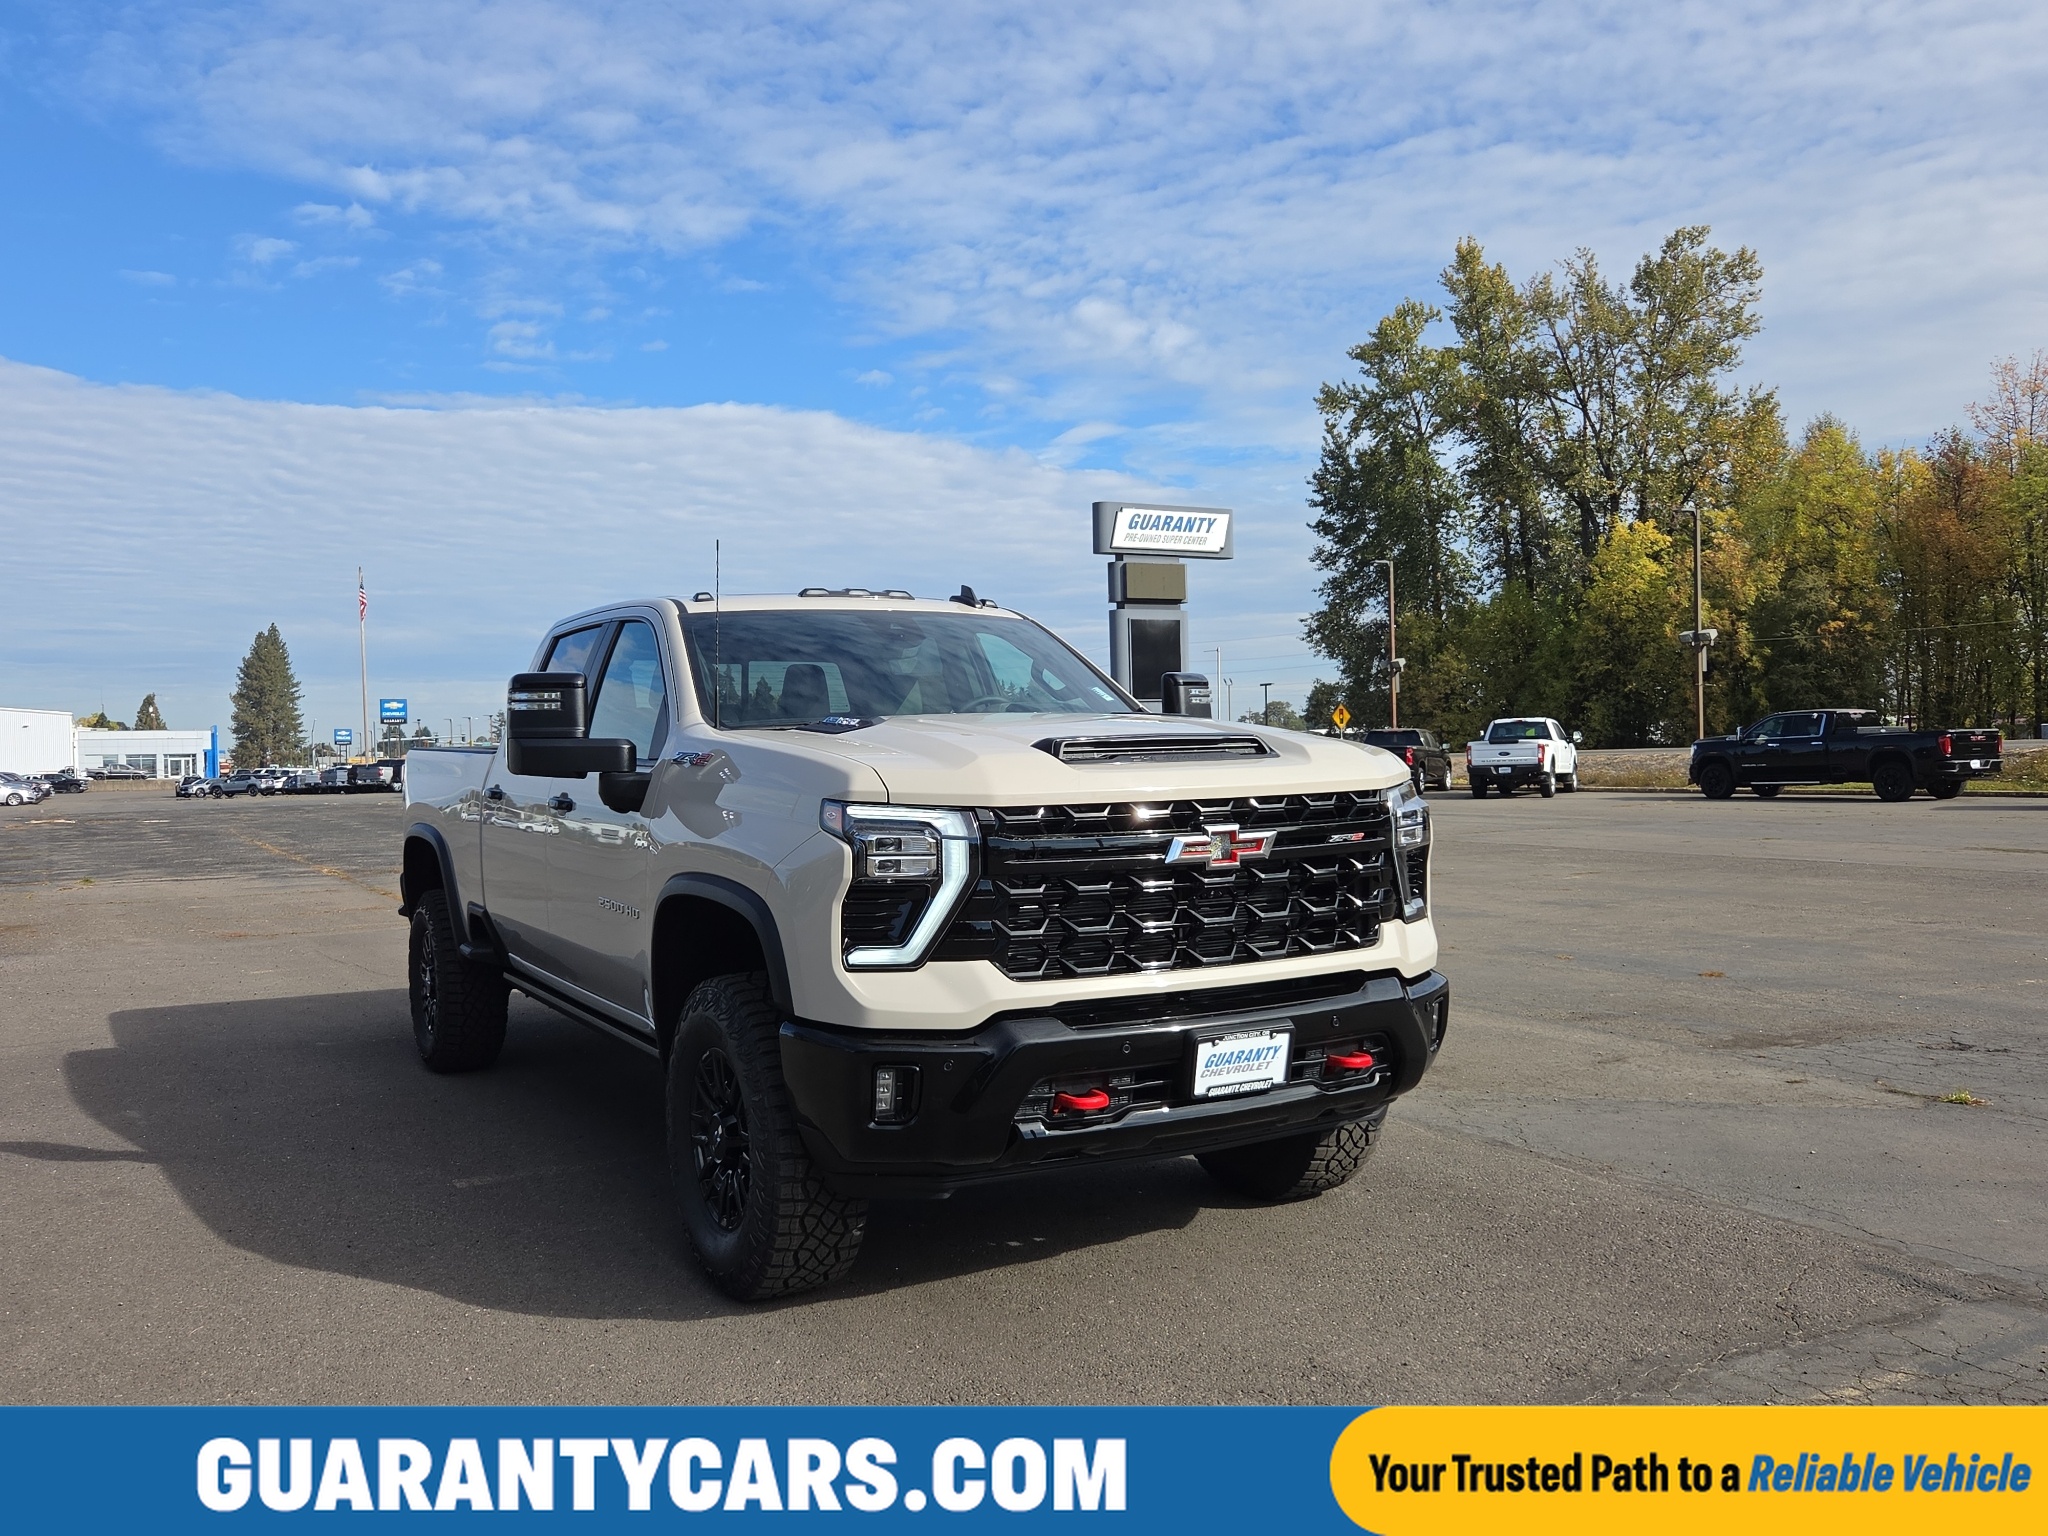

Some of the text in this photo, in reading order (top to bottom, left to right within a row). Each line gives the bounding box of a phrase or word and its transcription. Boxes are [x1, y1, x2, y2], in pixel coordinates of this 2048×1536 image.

[1128, 513, 1217, 534] GUARANTY
[1124, 533, 1208, 545] PRE-OWNED SUPER CENTER
[671, 751, 715, 767] ZR2
[1329, 832, 1365, 842] ZR2
[1223, 1033, 1248, 1041] JUNCTION
[1204, 1045, 1283, 1069] GUARANTY
[1200, 1060, 1273, 1079] CHEVROLET
[1240, 1080, 1273, 1092] CHEVROLET
